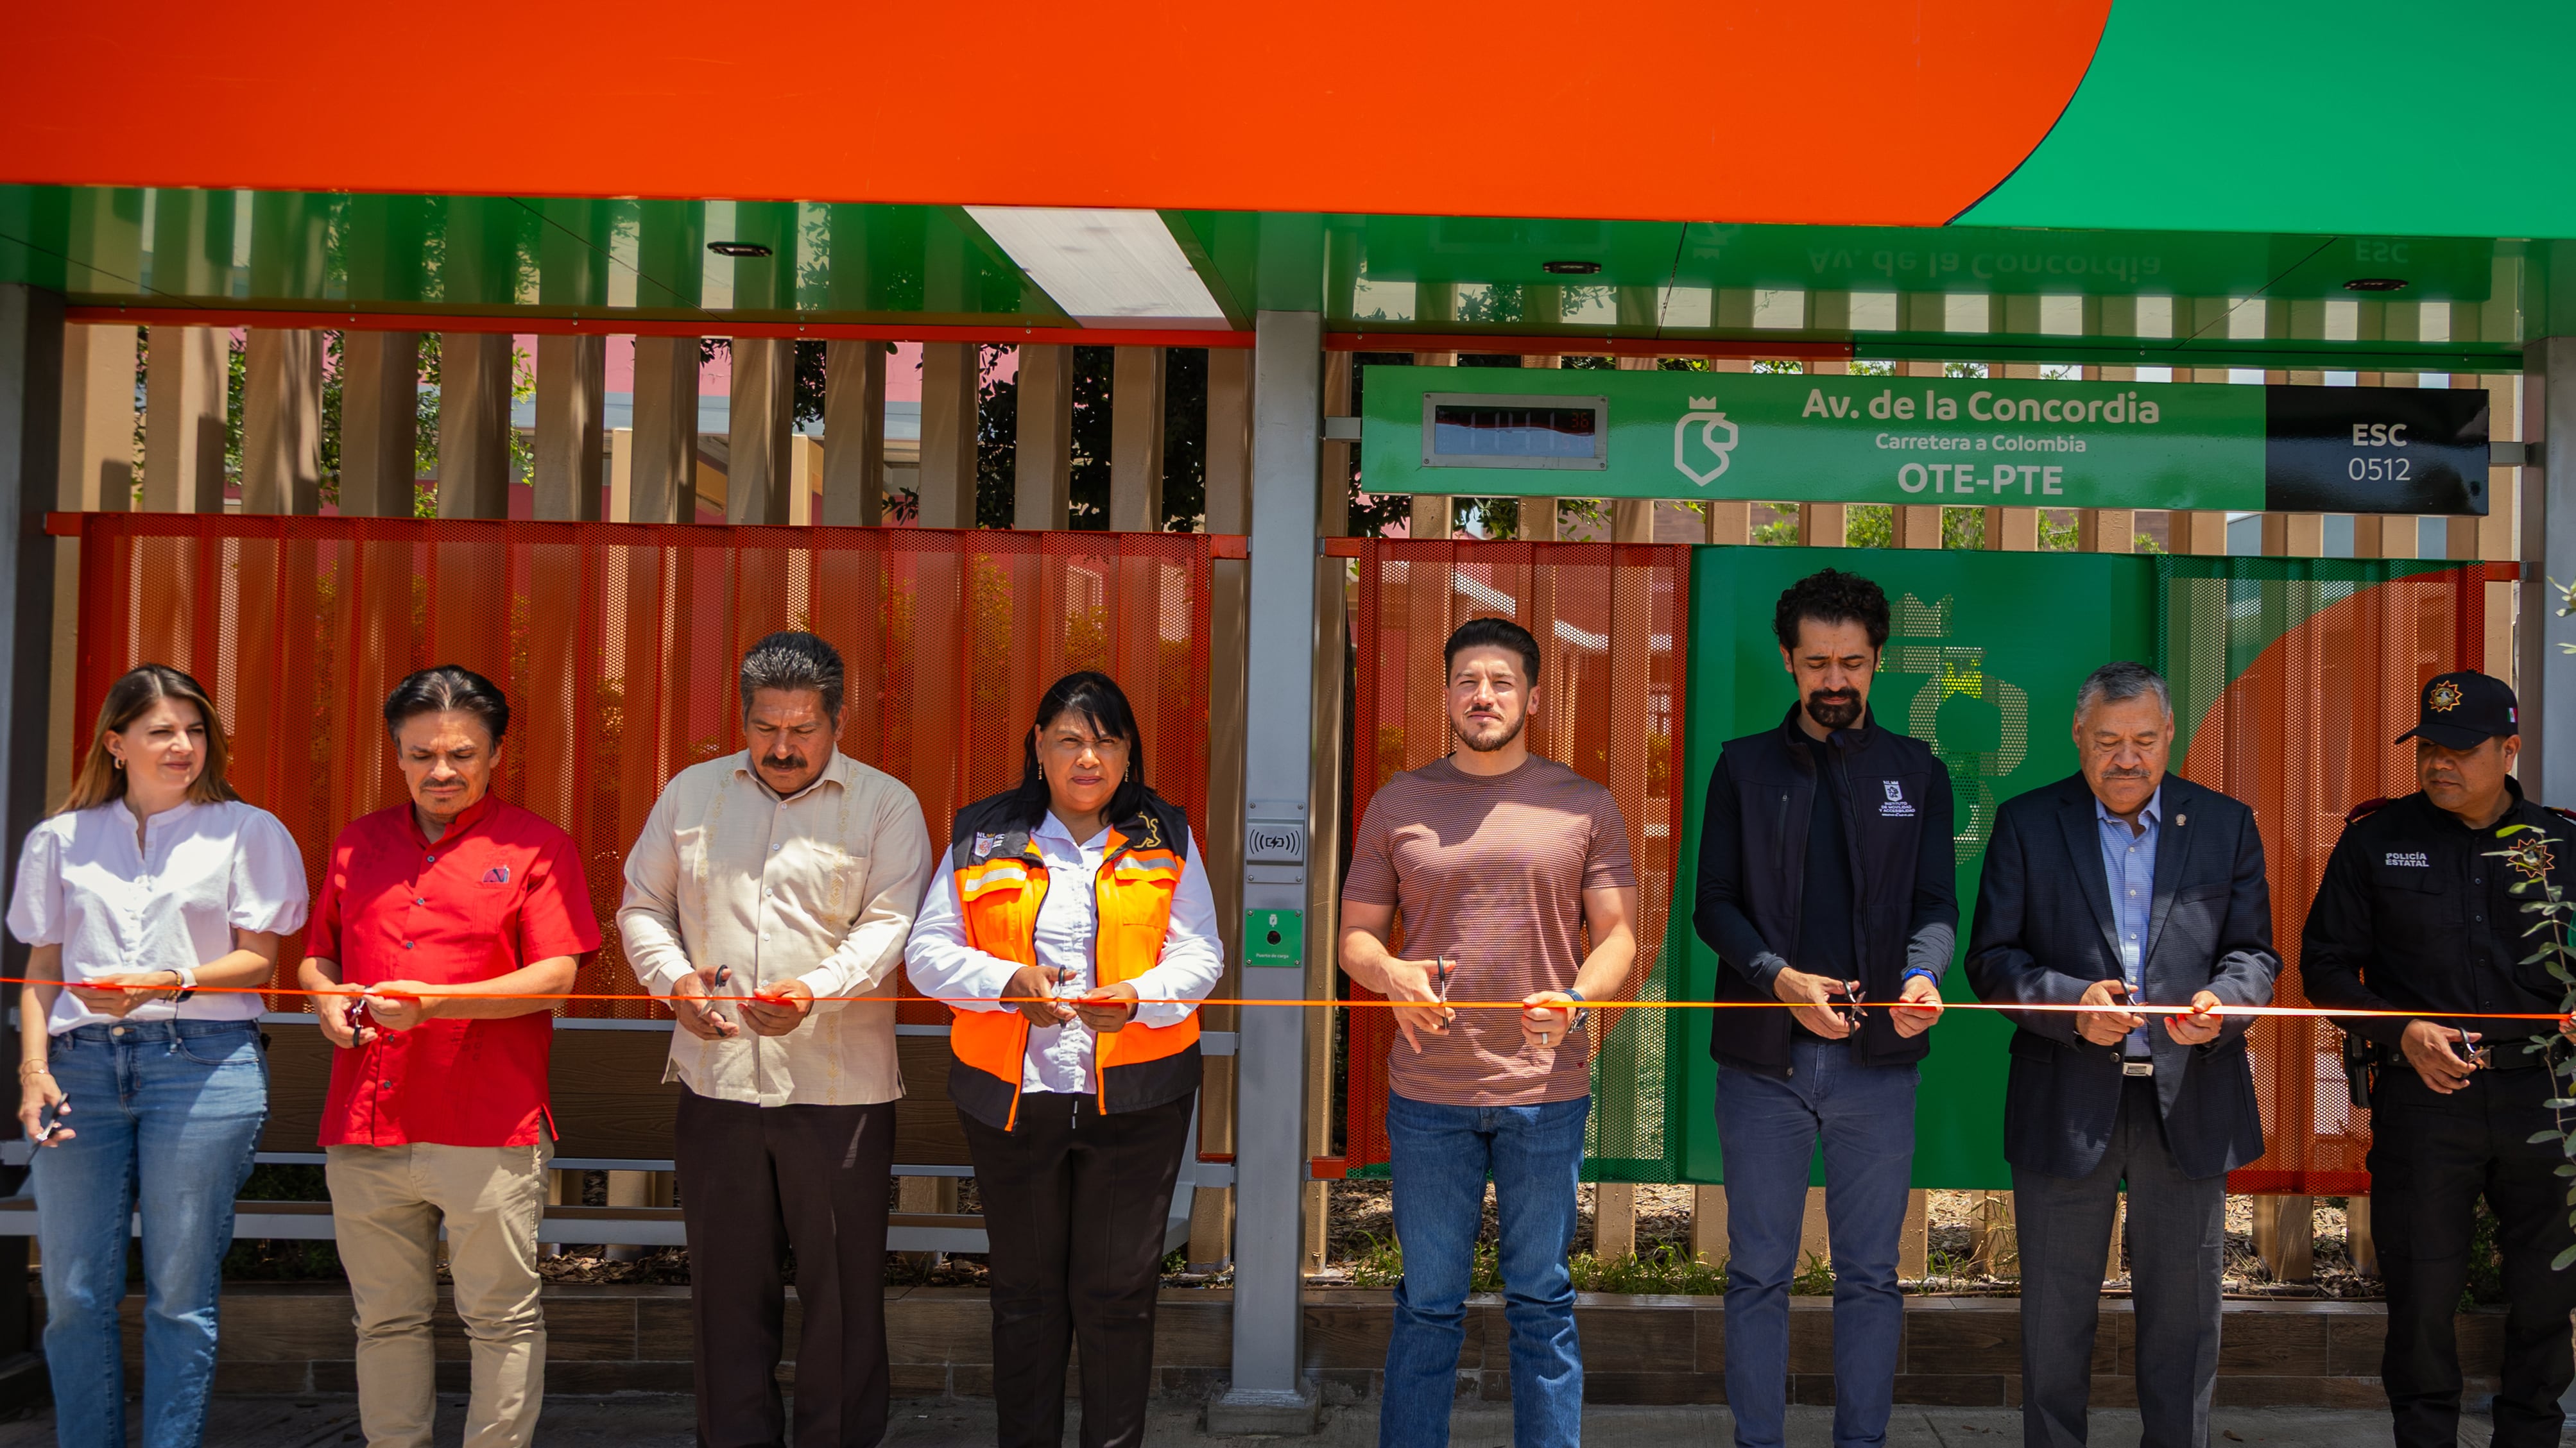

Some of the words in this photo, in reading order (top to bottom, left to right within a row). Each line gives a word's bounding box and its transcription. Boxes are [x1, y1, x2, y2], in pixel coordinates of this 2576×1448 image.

[1801, 388, 1860, 419] Av.
[1868, 389, 1915, 420] de
[1926, 390, 1957, 420] la
[1968, 391, 2160, 424] Concordia
[1875, 433, 1969, 450] Carretera
[1975, 439, 1988, 451] a
[1991, 434, 2086, 453] Colombia
[2353, 423, 2408, 447] ESC
[1897, 463, 2064, 495] OTE-PTE
[2348, 457, 2412, 481] 0512
[2385, 851, 2427, 860] POLICÍA
[2385, 859, 2430, 867] ESTATAL
